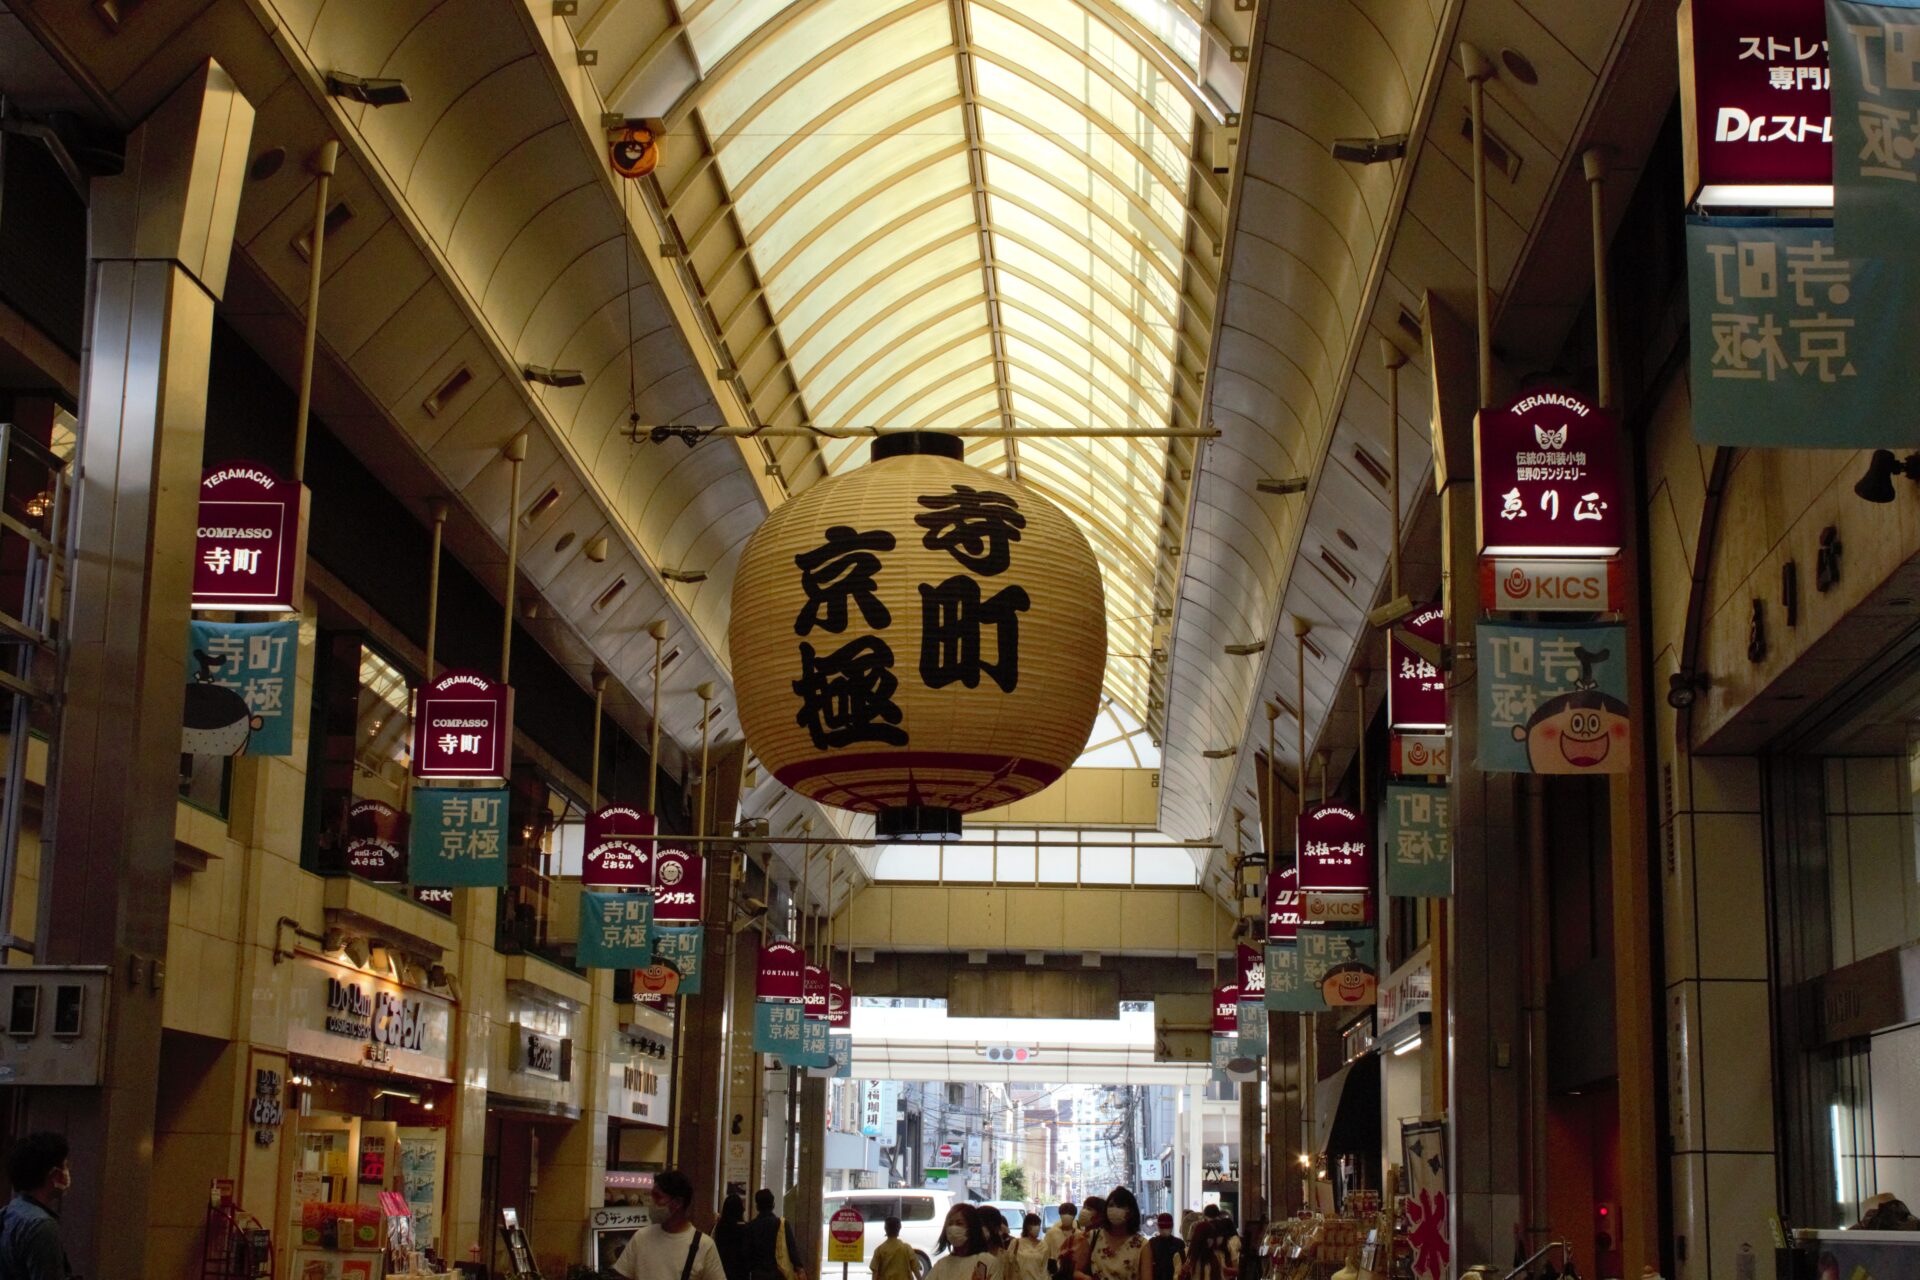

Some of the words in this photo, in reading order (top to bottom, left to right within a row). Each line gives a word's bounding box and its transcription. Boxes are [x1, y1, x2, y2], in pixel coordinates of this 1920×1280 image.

[1510, 393, 1590, 417] TERAMACHI
[1516, 452, 1586, 465] 伝統の和装小物
[203, 469, 275, 490] TERAMACHI
[1517, 467, 1587, 481] 世界のランジェリー
[197, 527, 273, 539] COMPASSO
[203, 546, 262, 575] 寺町
[914, 485, 1031, 693] 寺町
[1535, 576, 1601, 600] KICS
[792, 526, 910, 750] 京極
[207, 634, 288, 675] 寺町
[436, 675, 489, 692] TERAMACHI
[432, 718, 489, 728] COMPASSO
[438, 733, 482, 755] 寺町
[442, 796, 501, 827] 寺町
[600, 807, 640, 820] TERAMACHI
[1313, 808, 1356, 820] TERAMACHI
[439, 829, 499, 860] 京極
[602, 860, 634, 869] どおらん
[656, 849, 690, 861] TERAMACHI
[603, 901, 649, 923] 寺町
[1327, 902, 1361, 915] KICS
[601, 925, 647, 948] 京極
[762, 969, 800, 977] FONTAINE
[372, 992, 427, 1050] どおらん
[770, 1008, 800, 1023] 寺町
[769, 1024, 800, 1039] 京極
